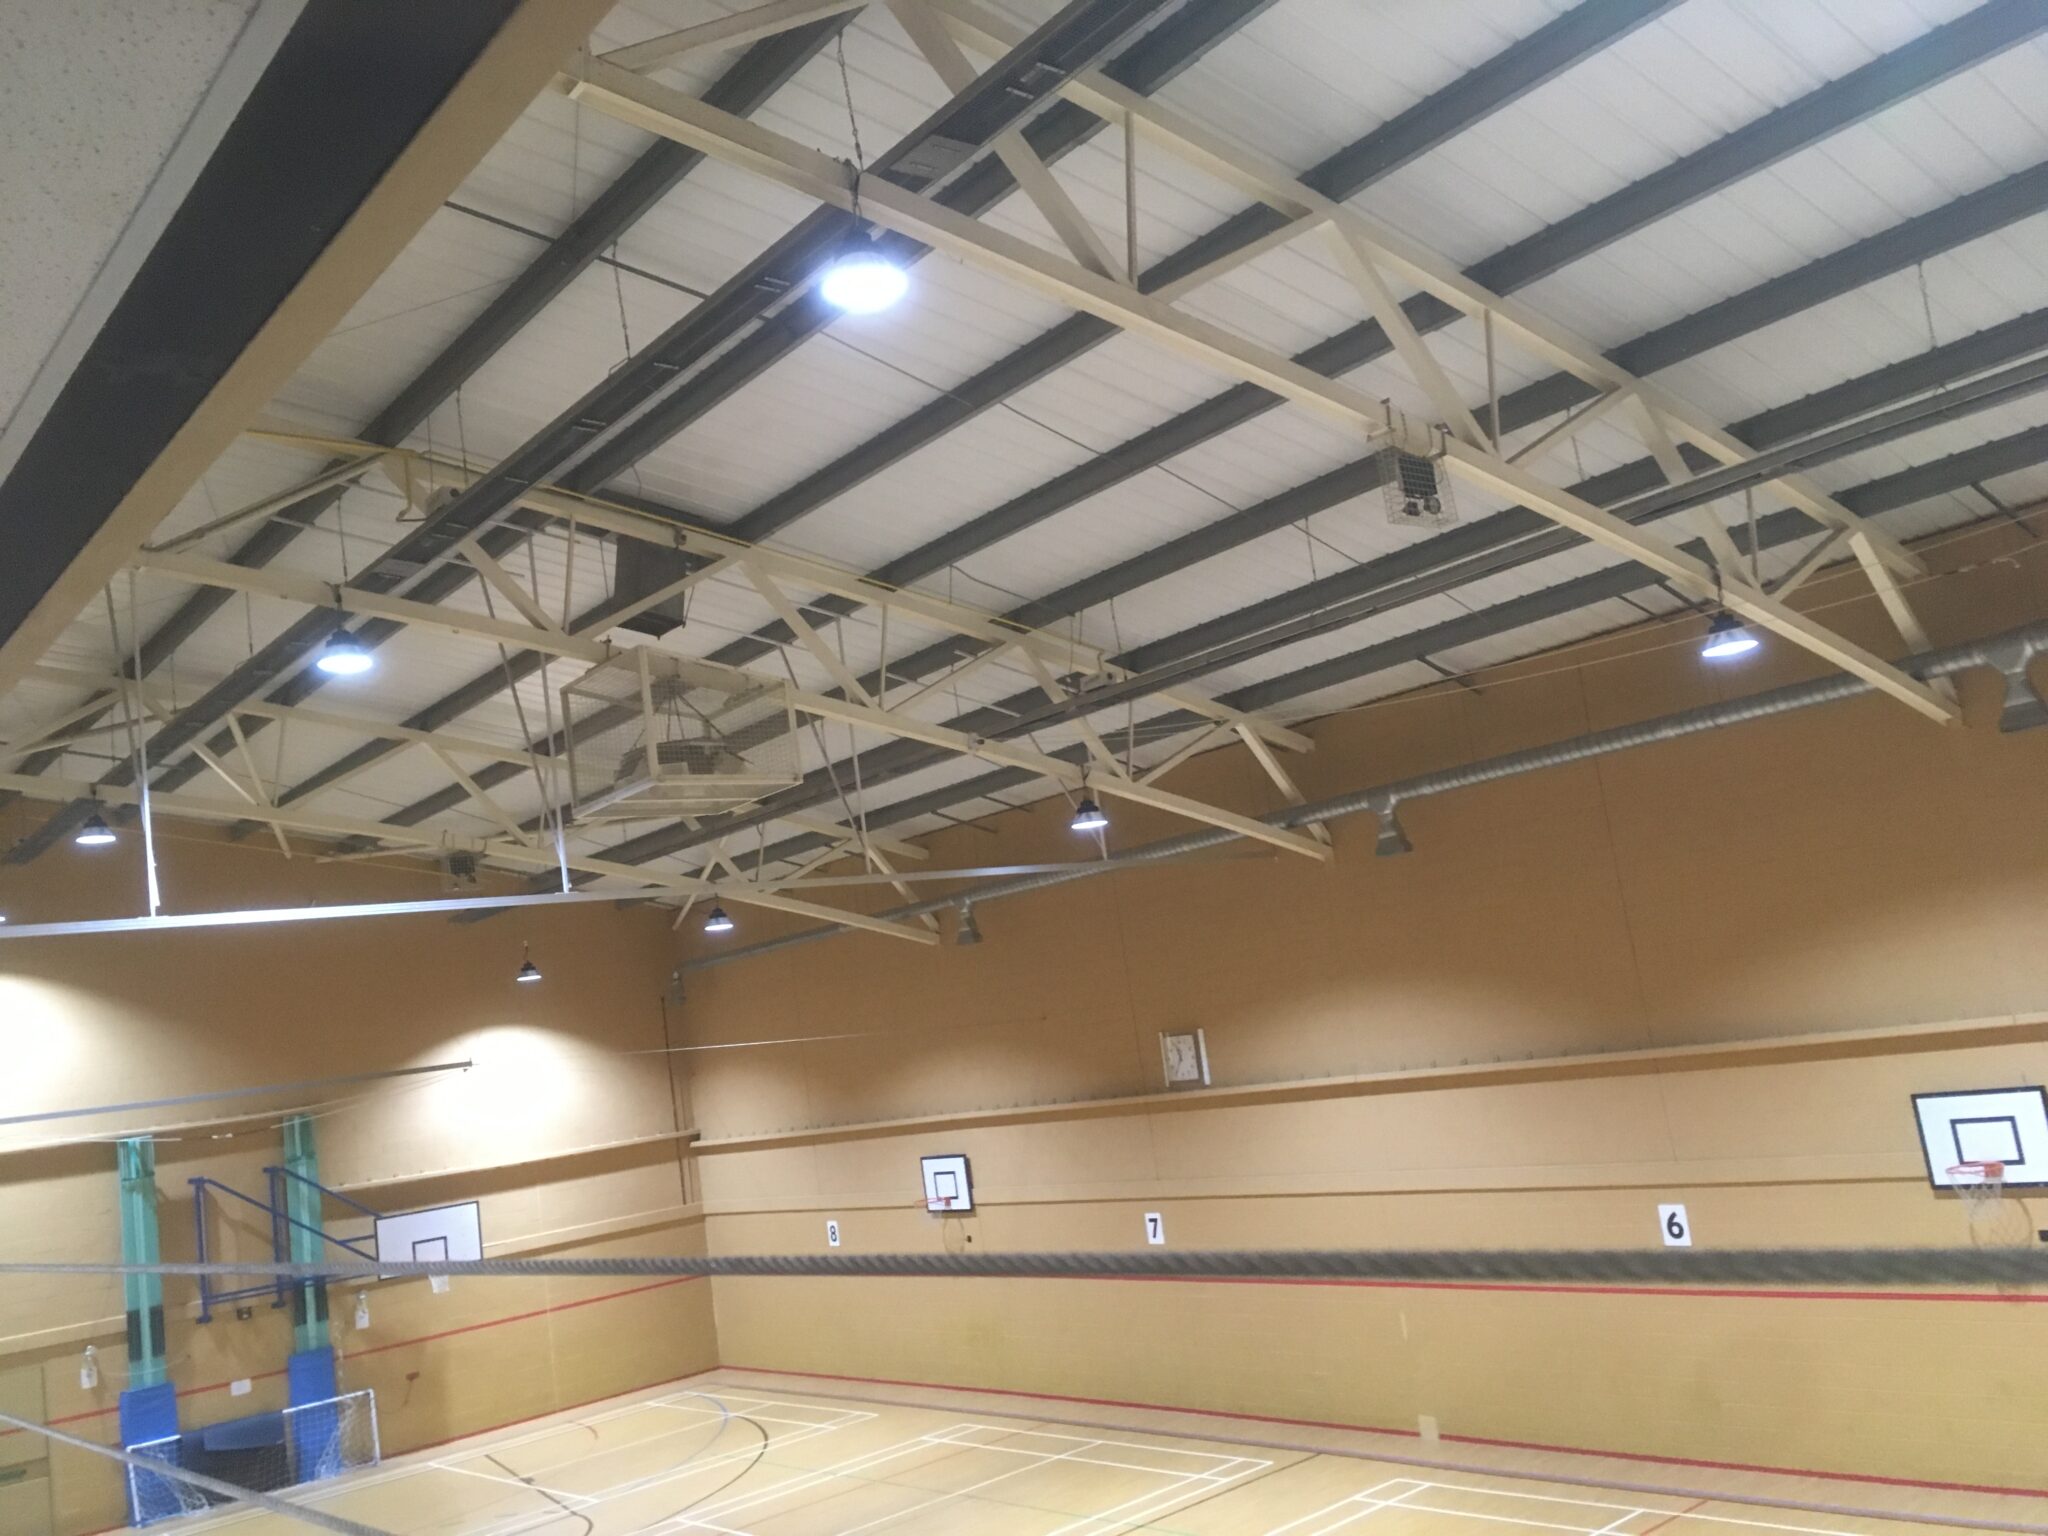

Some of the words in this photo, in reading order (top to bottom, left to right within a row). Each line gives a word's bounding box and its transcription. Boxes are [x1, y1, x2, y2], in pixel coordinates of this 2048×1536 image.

[830, 1225, 838, 1242] 8
[1148, 1218, 1158, 1238] 7
[1667, 1211, 1684, 1239] 6
